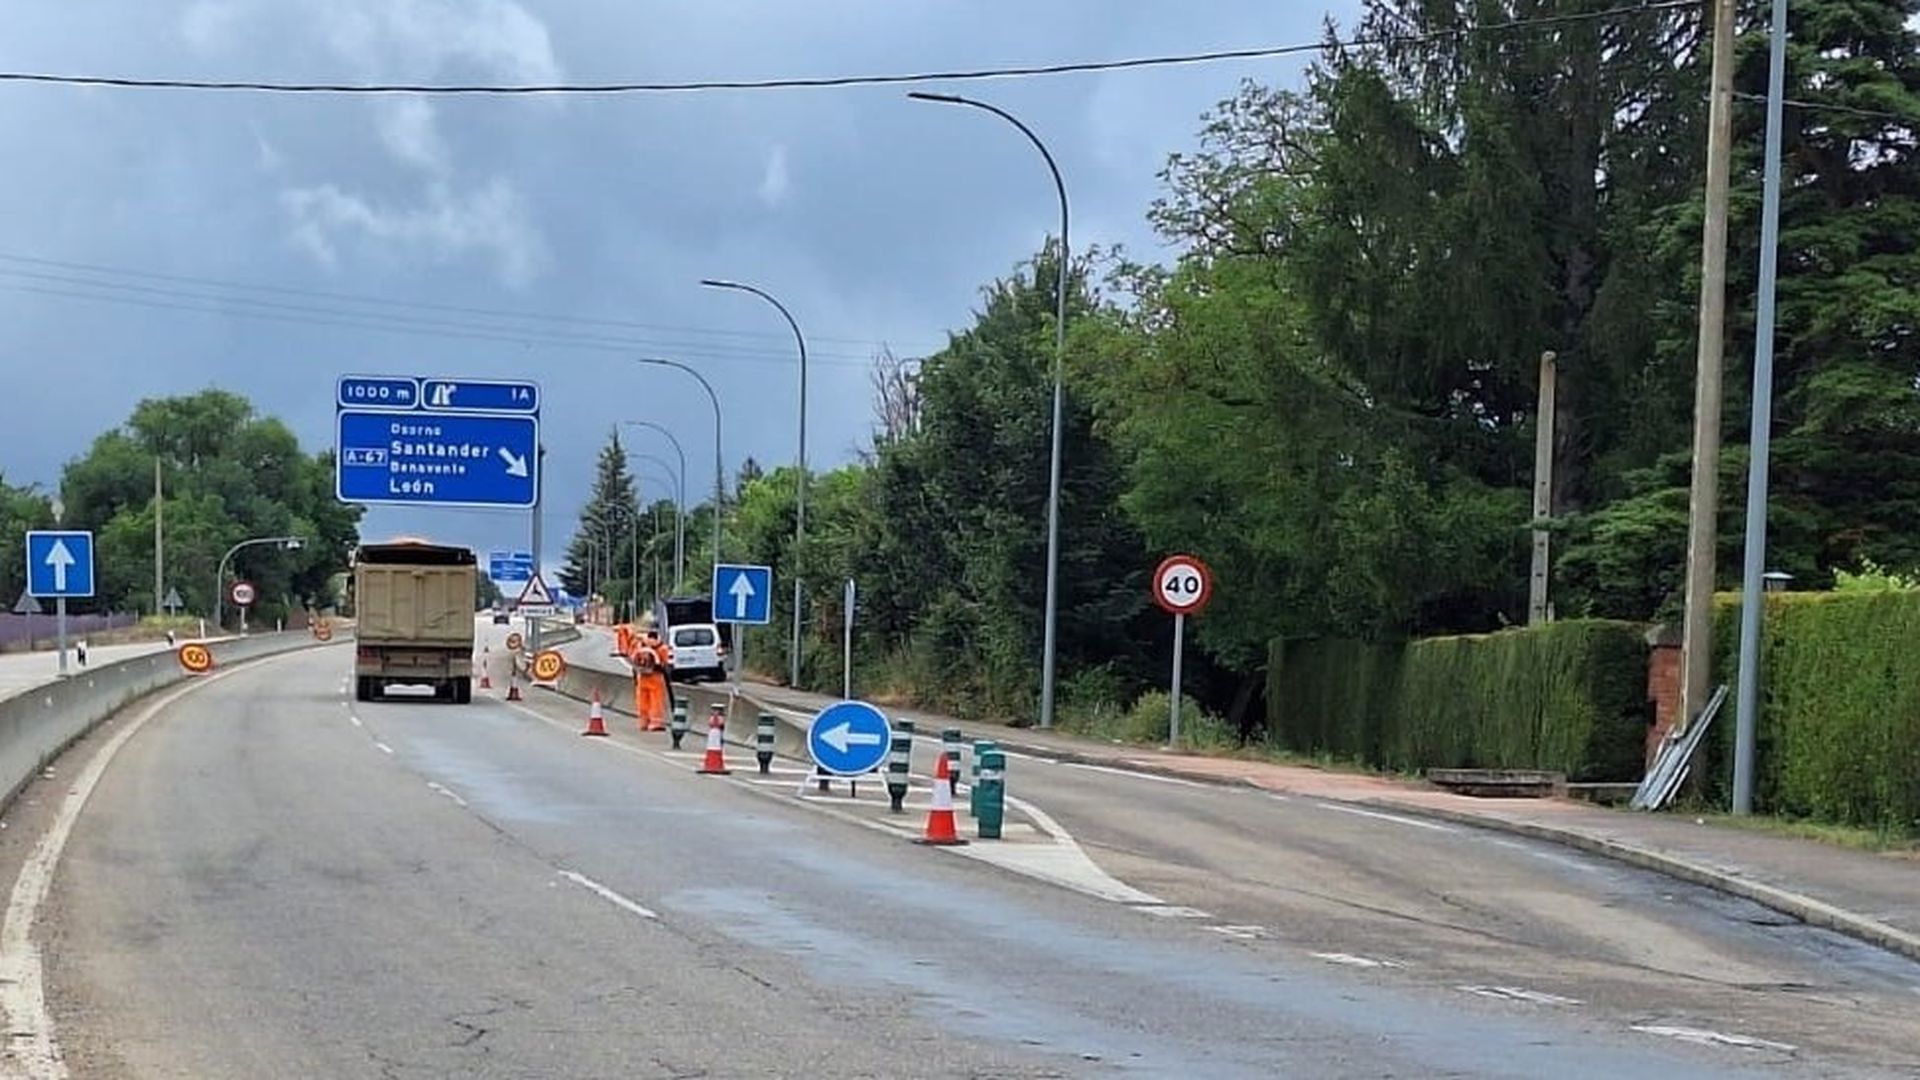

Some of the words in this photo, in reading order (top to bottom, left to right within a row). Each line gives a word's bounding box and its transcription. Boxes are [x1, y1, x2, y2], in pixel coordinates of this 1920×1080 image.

[348, 385, 390, 399] 1000
[396, 388, 410, 400] m
[511, 387, 530, 401] 1A
[391, 440, 489, 458] Santander
[347, 451, 384, 463] A-67
[390, 478, 434, 494] León
[1165, 576, 1199, 594] 40
[187, 650, 206, 664] 100
[538, 657, 558, 672] 100
